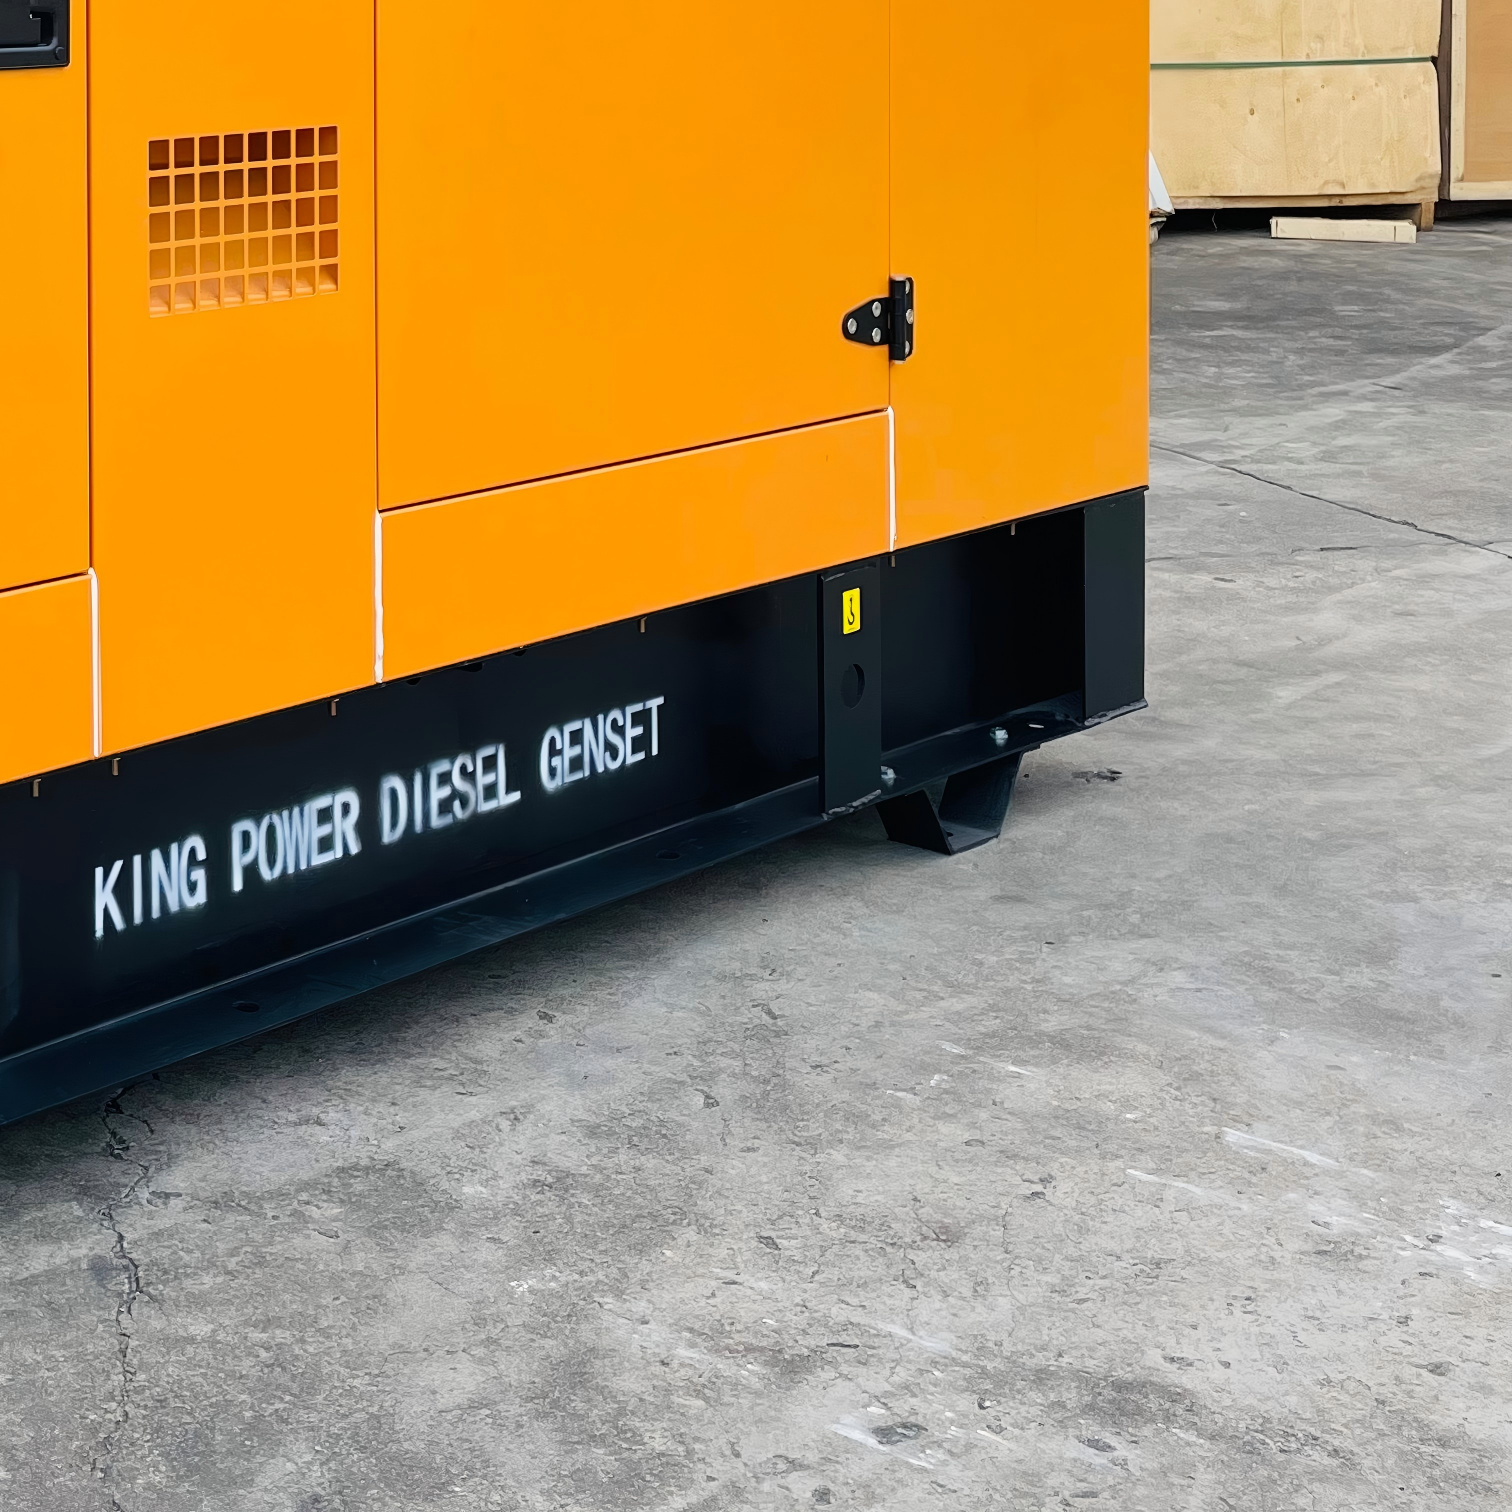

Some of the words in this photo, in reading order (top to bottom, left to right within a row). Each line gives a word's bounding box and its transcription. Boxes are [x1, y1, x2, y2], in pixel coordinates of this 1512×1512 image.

[93, 834, 208, 939] KING
[230, 788, 361, 892] POWER
[379, 742, 521, 845] DIESEL
[539, 695, 665, 791] GENSET
